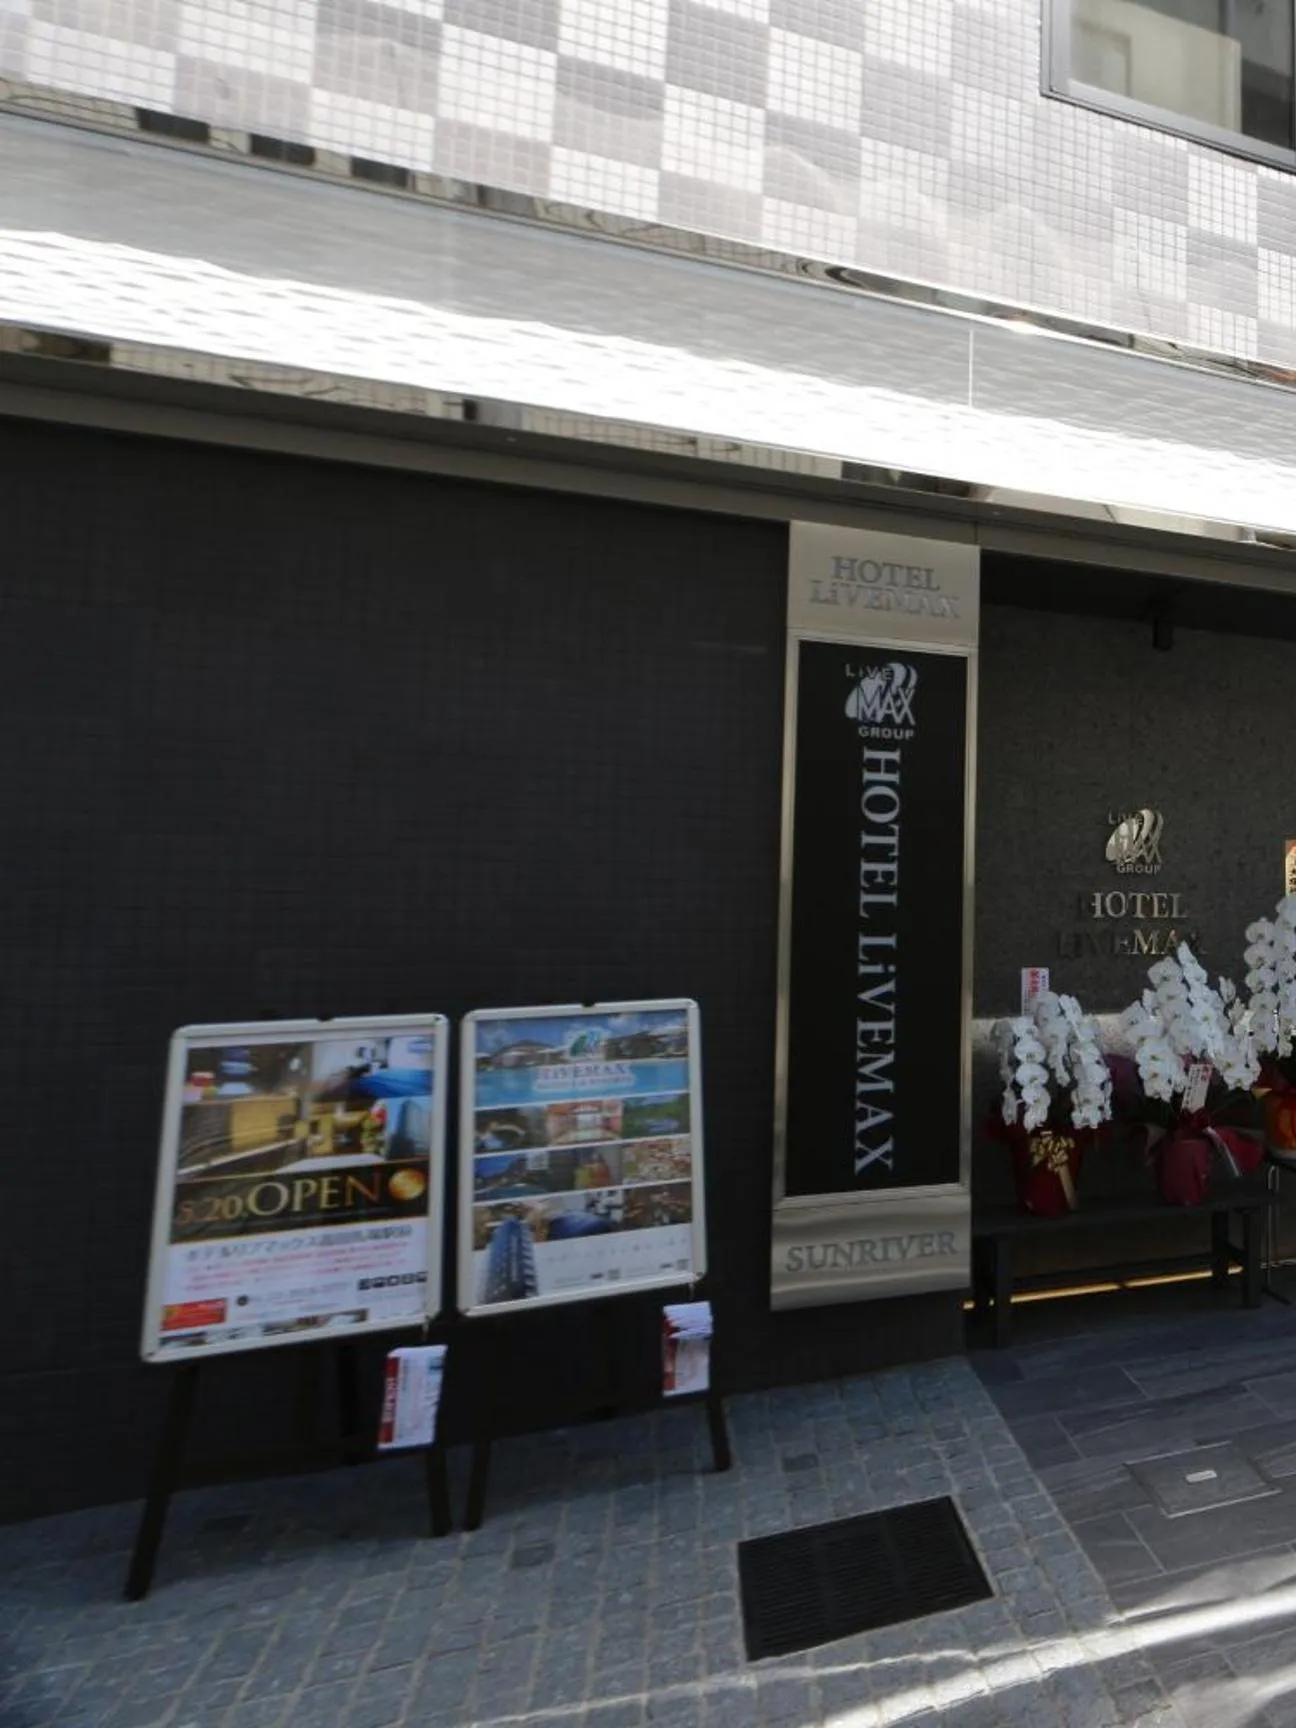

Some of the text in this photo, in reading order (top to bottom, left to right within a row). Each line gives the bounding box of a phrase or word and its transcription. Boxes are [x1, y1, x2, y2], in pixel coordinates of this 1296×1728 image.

[831, 556, 941, 592] HOTEL
[858, 725, 915, 741] GROUP
[858, 746, 900, 919] HOTEL
[1116, 863, 1162, 875] GROUP
[1076, 891, 1189, 919] HOTEL
[247, 1170, 381, 1217] OPEN
[785, 1231, 959, 1273] SUNRIVER
